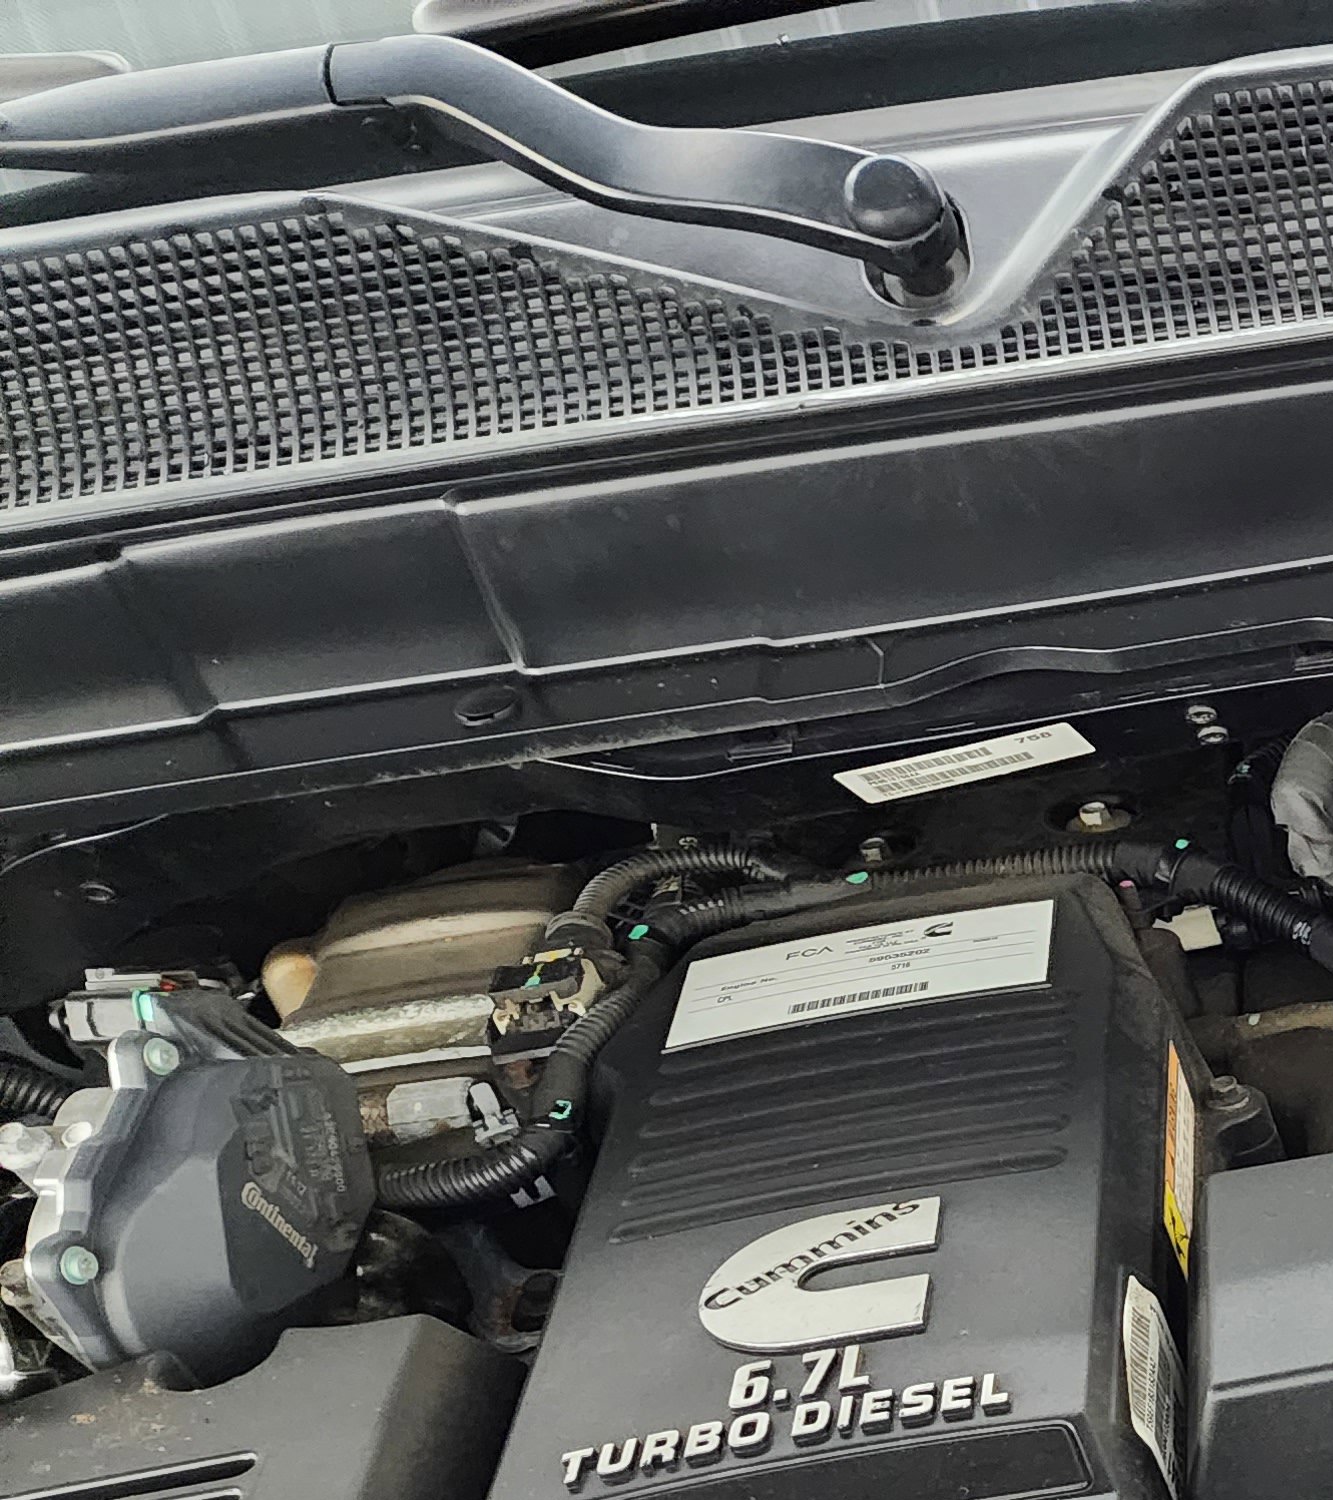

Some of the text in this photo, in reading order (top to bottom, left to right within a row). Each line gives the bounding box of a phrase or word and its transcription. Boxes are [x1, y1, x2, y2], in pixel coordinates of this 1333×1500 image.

[785, 946, 834, 962] FCA
[241, 1180, 319, 1269] Continental
[703, 1200, 921, 1310] Cummins
[729, 1344, 871, 1413] 6.7L
[561, 1372, 1011, 1488] TURBO DIESEL
